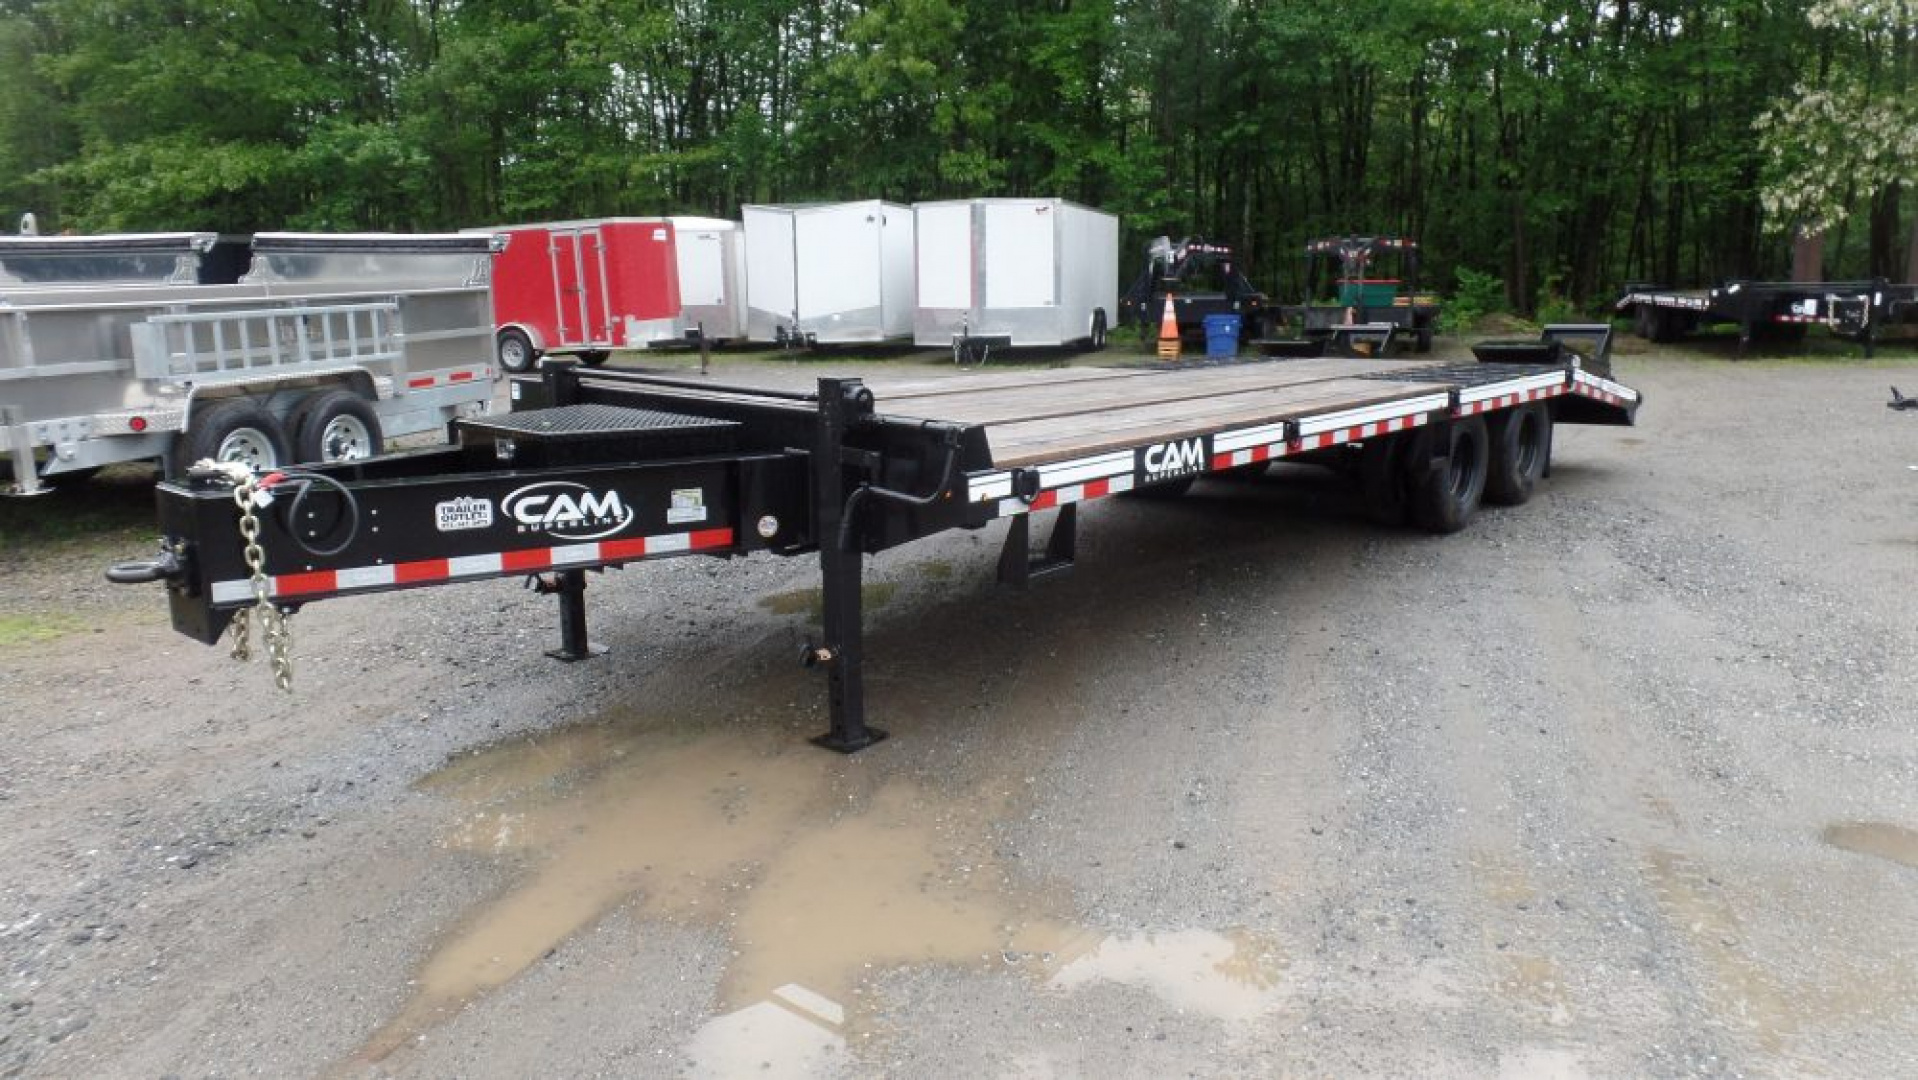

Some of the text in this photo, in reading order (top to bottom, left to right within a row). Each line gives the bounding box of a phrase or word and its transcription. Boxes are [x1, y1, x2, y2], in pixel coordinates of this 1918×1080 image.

[1144, 437, 1204, 473] CAM
[440, 503, 486, 514] TRAILER
[441, 512, 481, 522] OUTLET
[514, 490, 624, 523] CAM
